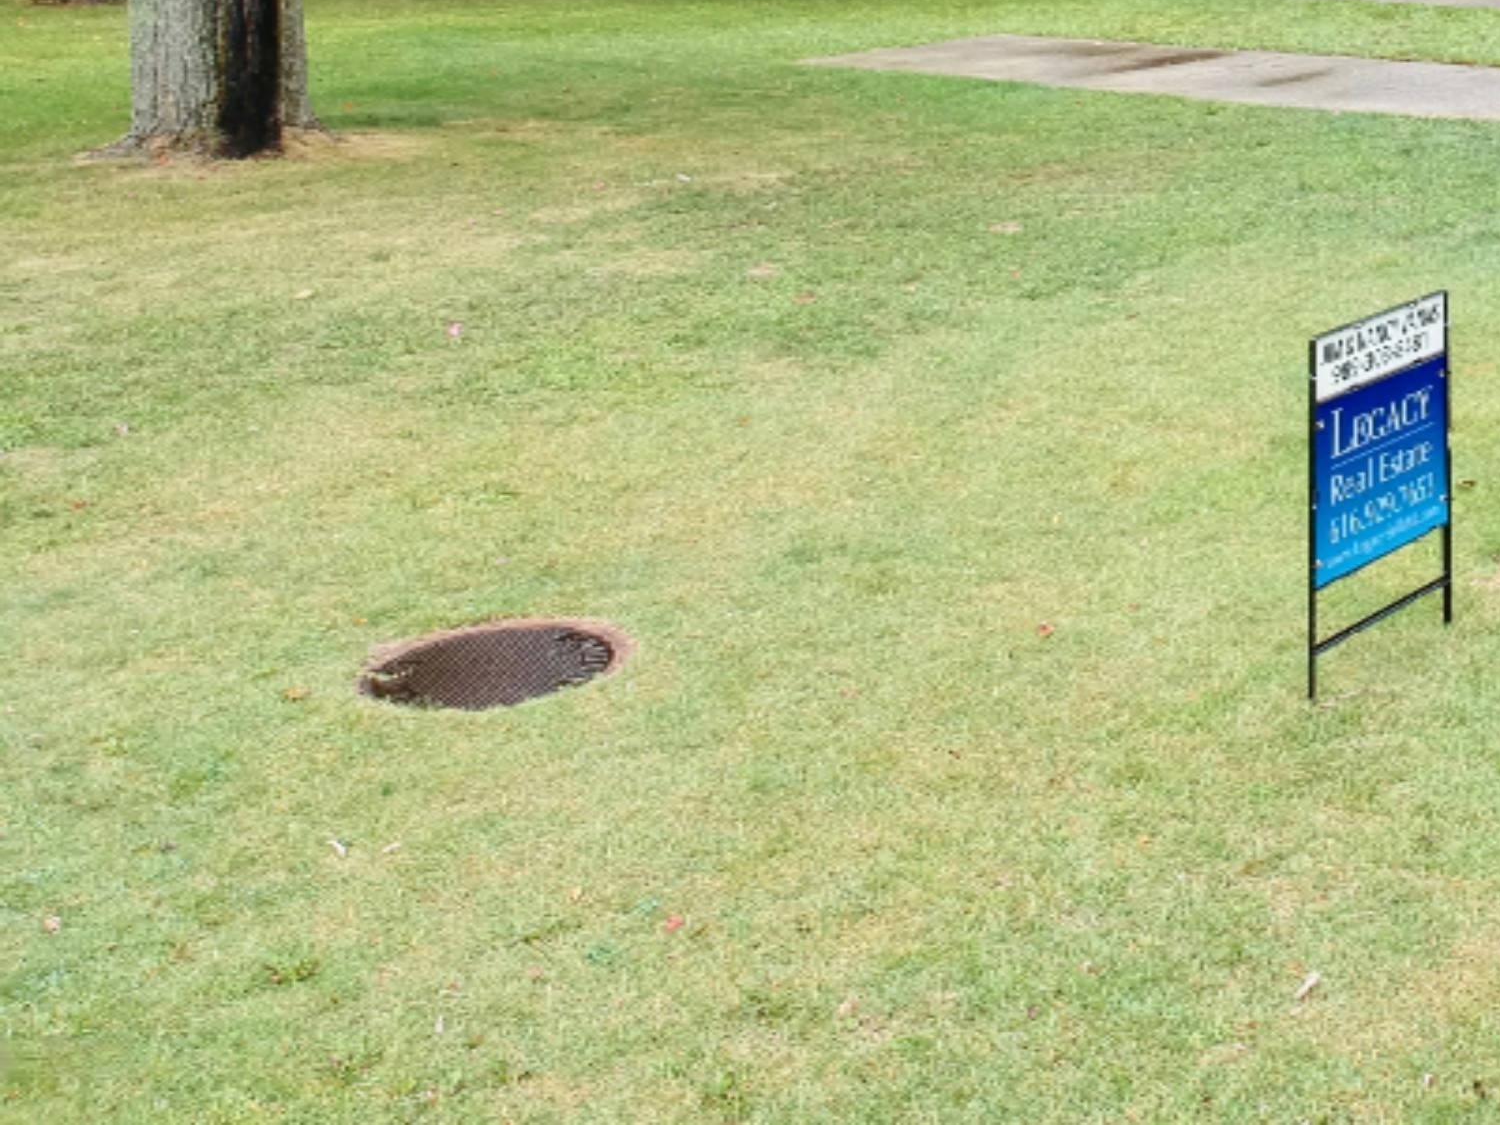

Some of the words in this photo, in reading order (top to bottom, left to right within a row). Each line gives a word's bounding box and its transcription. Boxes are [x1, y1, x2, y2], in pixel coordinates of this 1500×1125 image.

[1330, 385, 1434, 459] LEGACY
[1330, 457, 1374, 507] Real
[1378, 441, 1434, 483] Estate
